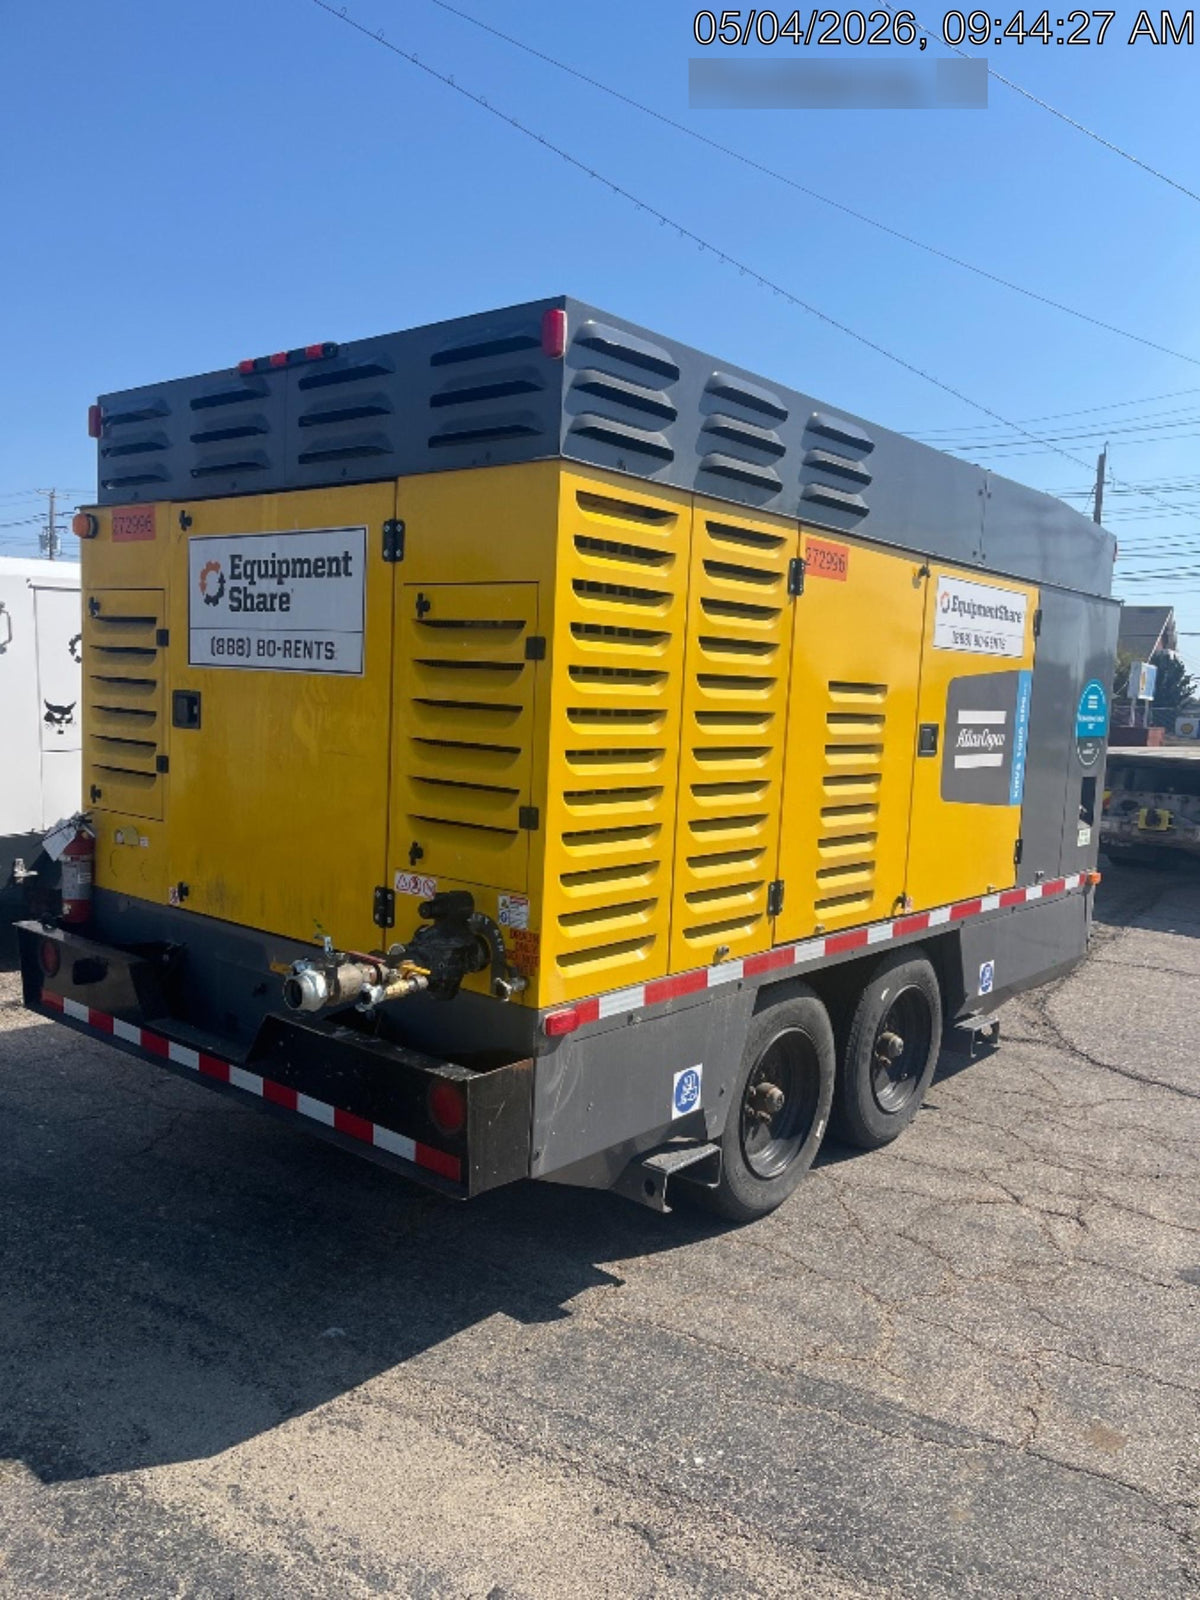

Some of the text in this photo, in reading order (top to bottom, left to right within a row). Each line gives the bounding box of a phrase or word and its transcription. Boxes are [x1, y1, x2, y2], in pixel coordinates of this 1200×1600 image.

[228, 550, 353, 585] Equipment
[805, 546, 846, 574] 272996
[228, 586, 292, 613] Share
[210, 635, 338, 661] (888) 80-RENTS
